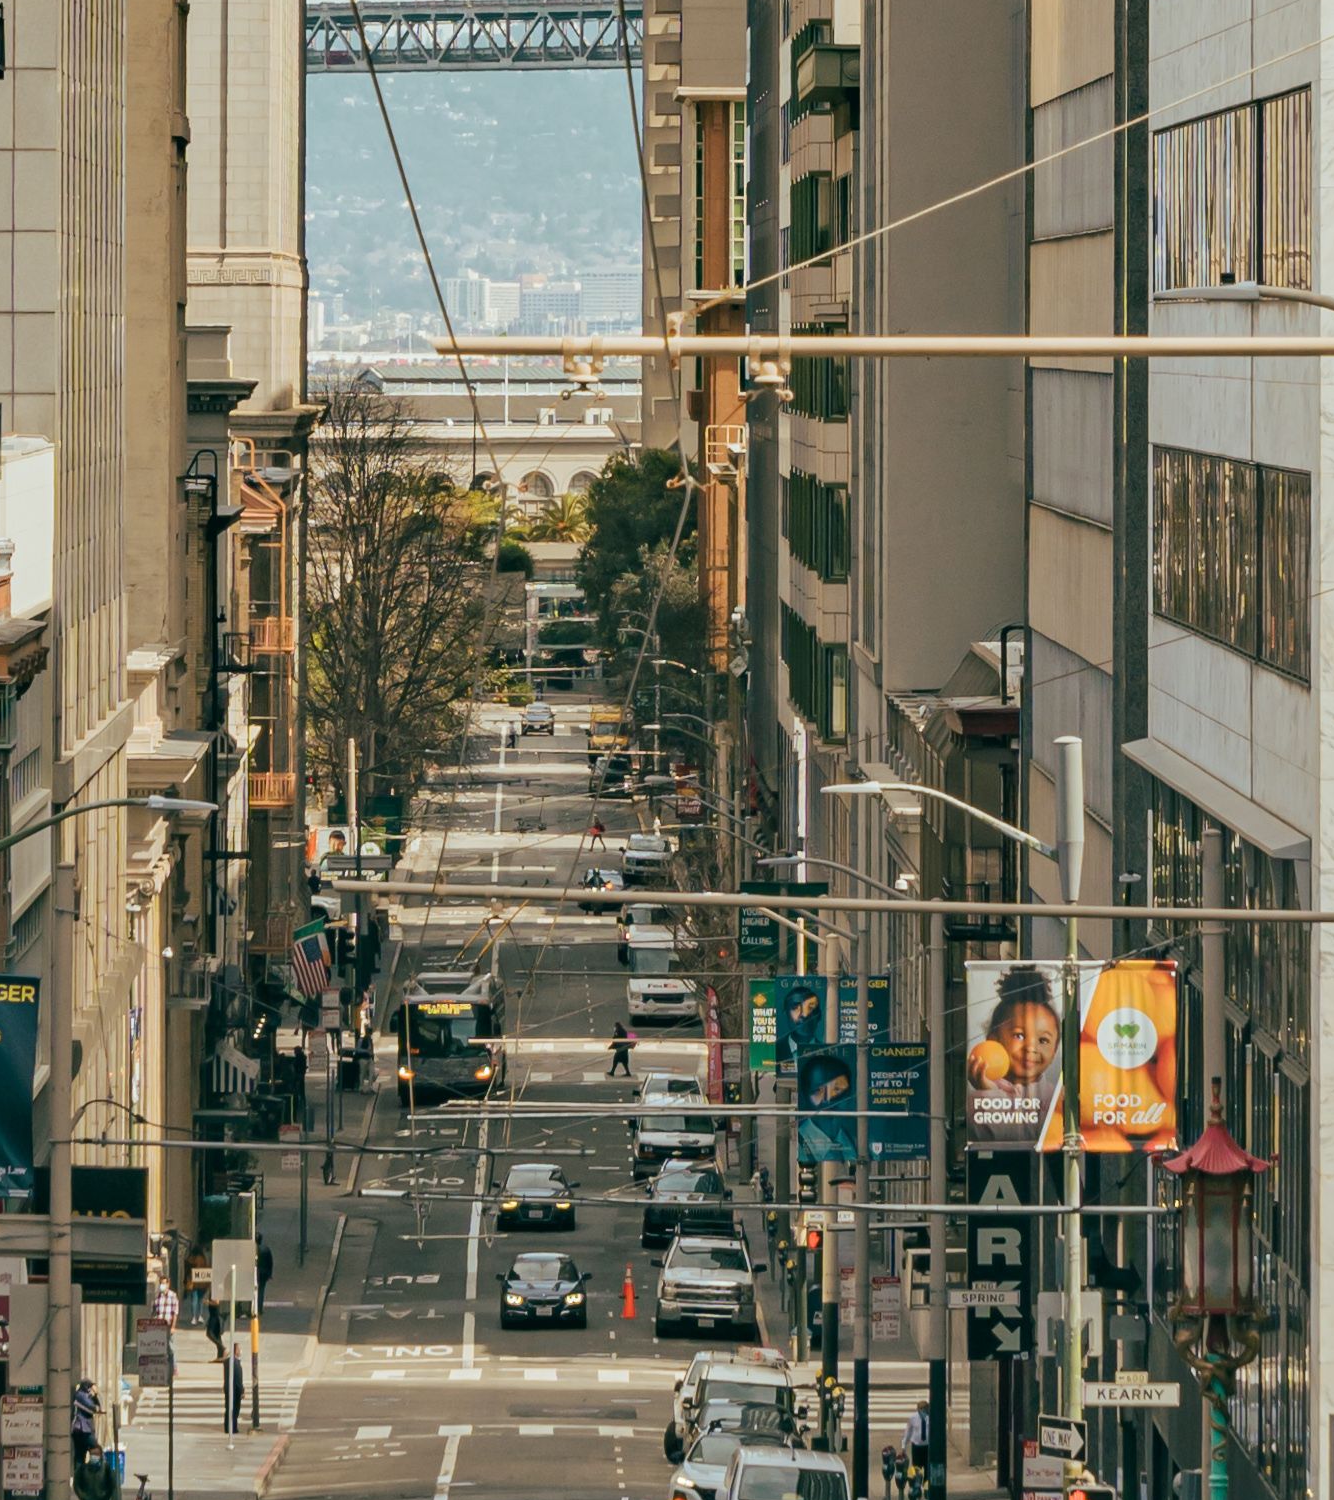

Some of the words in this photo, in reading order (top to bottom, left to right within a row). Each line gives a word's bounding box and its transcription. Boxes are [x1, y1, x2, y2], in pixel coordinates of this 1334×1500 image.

[871, 1047, 925, 1057] CHANGER
[974, 1098, 1012, 1110] FOOD
[1014, 1098, 1040, 1110] FOR
[1094, 1093, 1142, 1108] FOOD
[974, 1112, 1039, 1124] GROWING
[1093, 1111, 1127, 1125] FOR
[1130, 1103, 1167, 1125] all
[962, 1293, 1006, 1304] SPRING
[339, 1345, 454, 1358] ONLY
[1096, 1388, 1165, 1401] KEARNY
[1043, 1430, 1056, 1446] ONE
[1058, 1433, 1072, 1449] WAY
